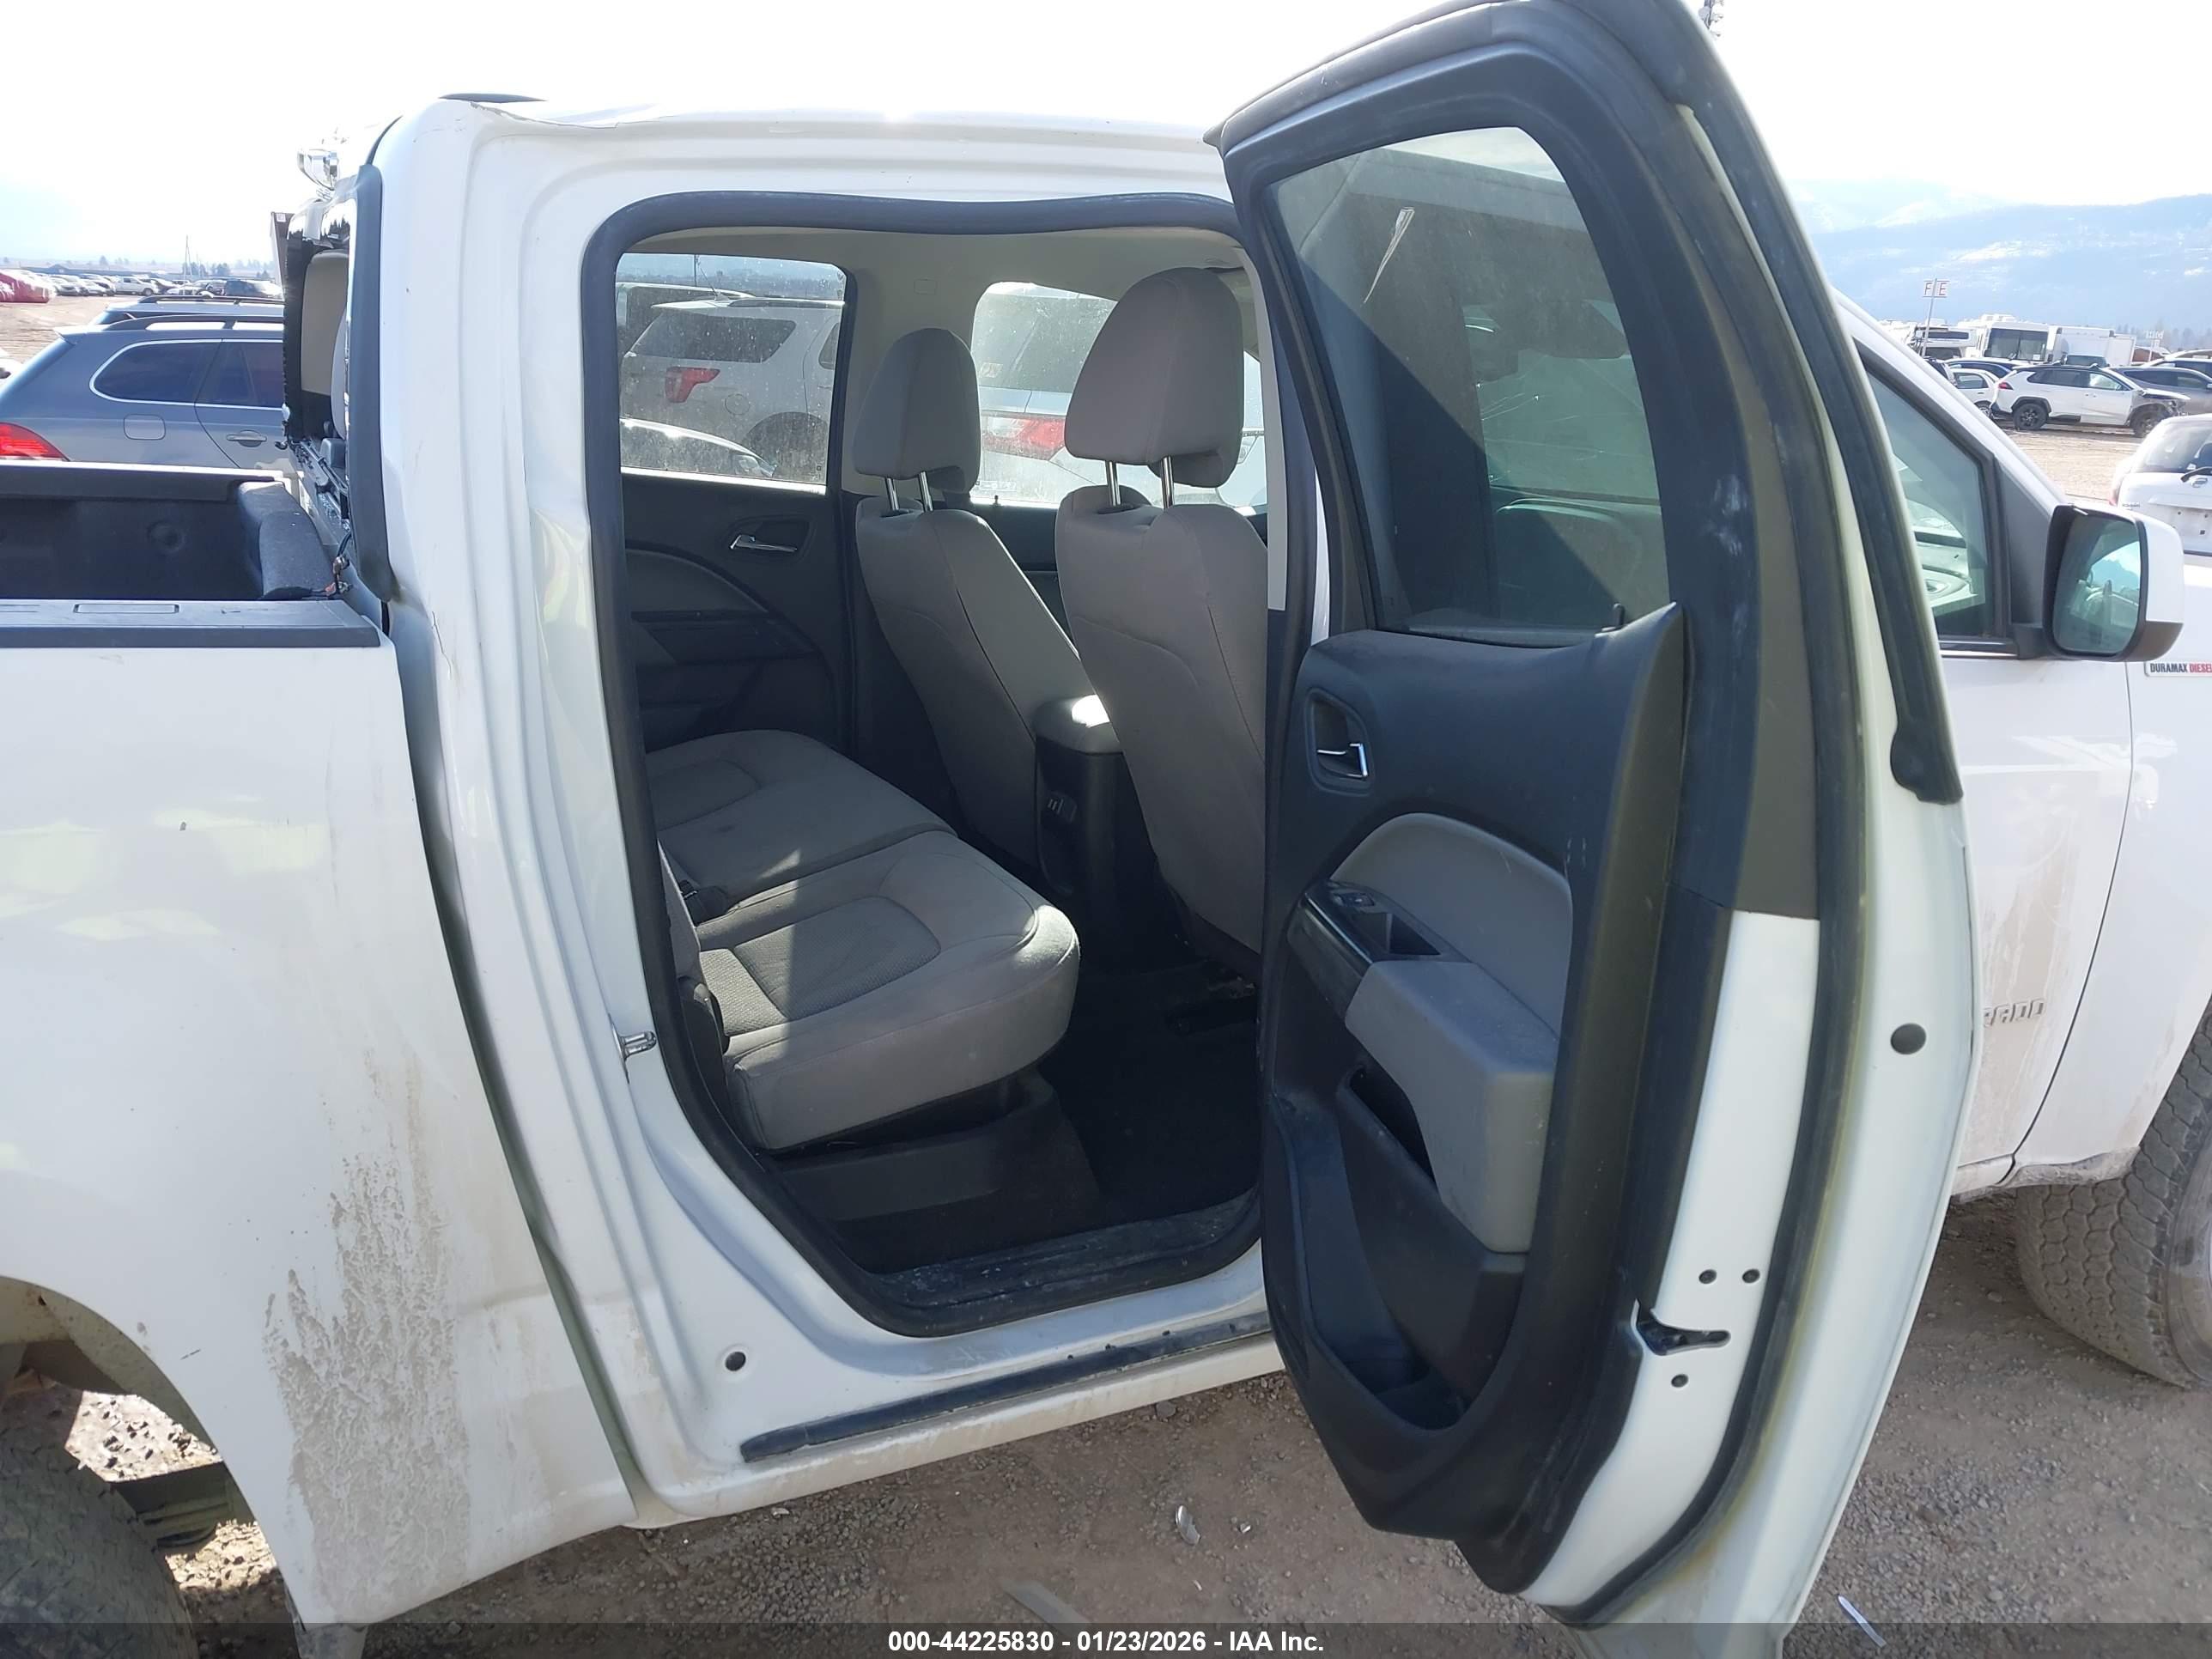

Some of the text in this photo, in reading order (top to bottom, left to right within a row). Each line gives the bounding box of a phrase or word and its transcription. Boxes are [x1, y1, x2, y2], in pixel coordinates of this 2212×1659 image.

[1923, 282, 1948, 296] F E
[2149, 663, 2188, 673] DURAMAX
